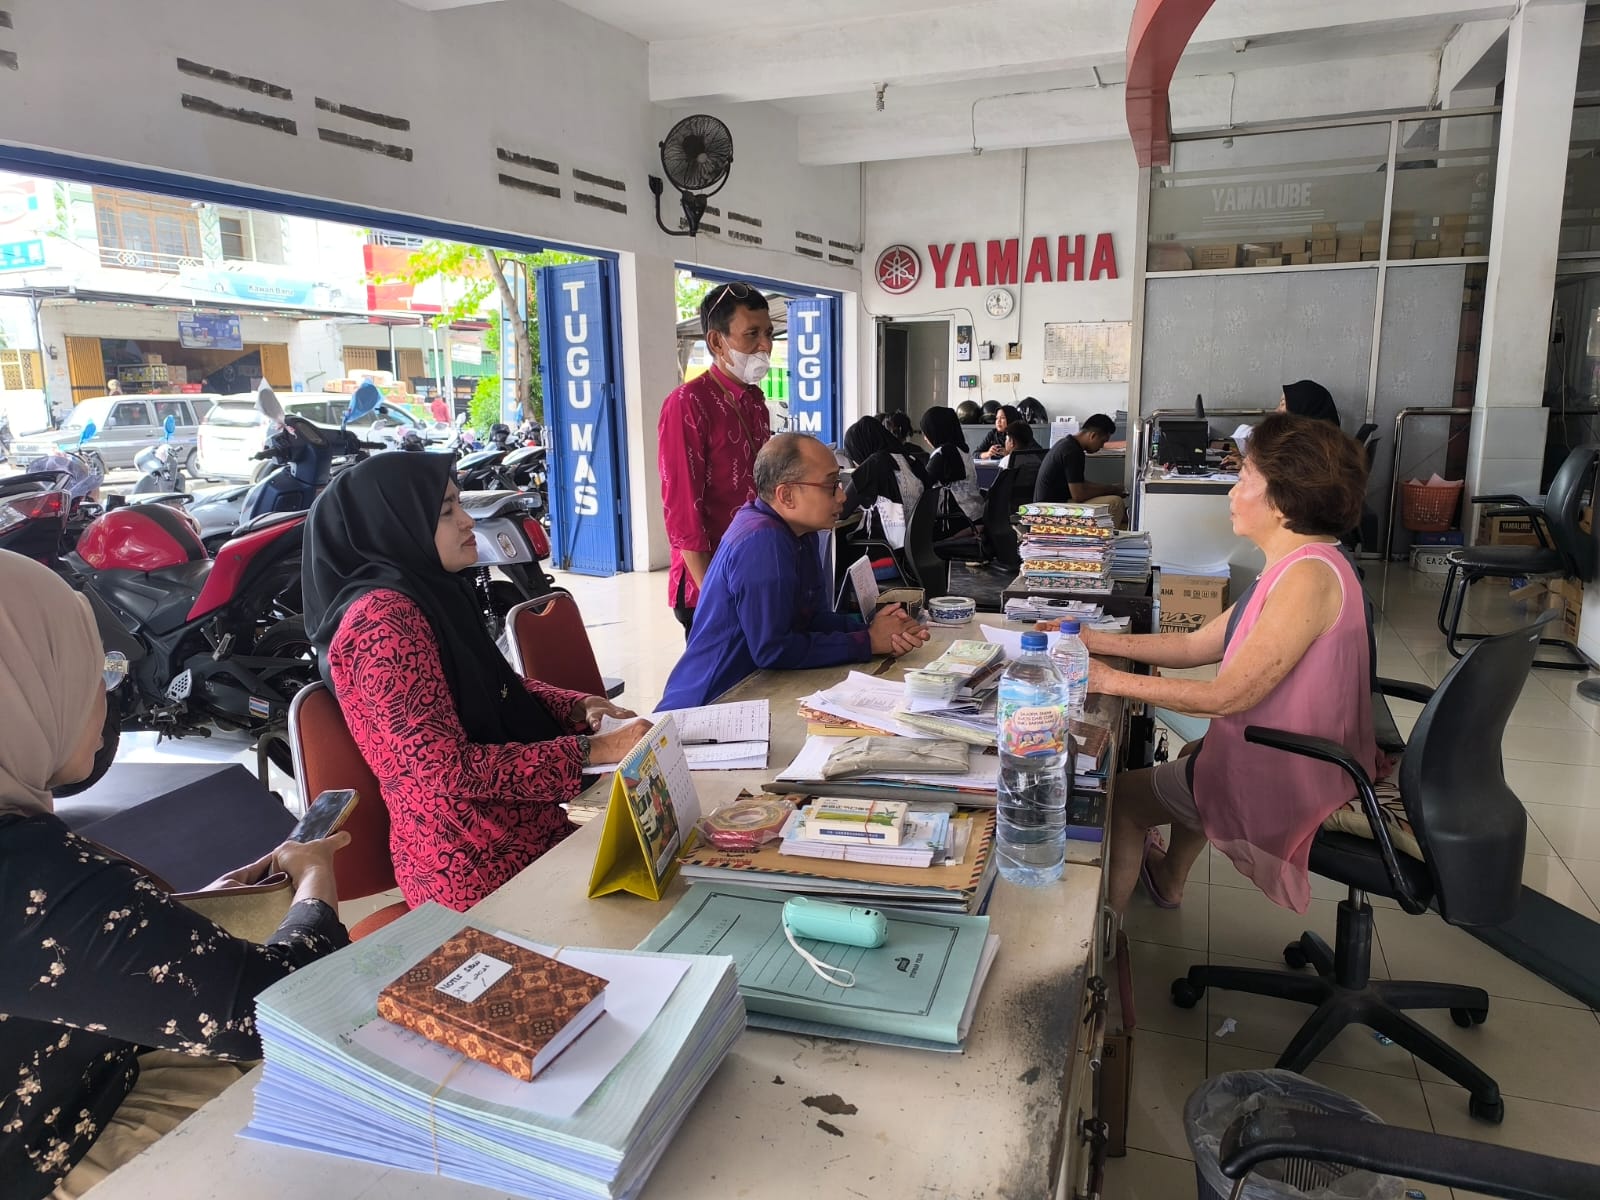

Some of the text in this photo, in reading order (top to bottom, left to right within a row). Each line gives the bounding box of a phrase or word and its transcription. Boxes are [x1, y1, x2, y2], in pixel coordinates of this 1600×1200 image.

[1211, 182, 1313, 212] YAMALUBE
[928, 233, 1118, 289] YAMAHA
[798, 311, 821, 401] TUGU
[562, 281, 599, 515] TUGU MAS
[1502, 522, 1532, 530] YAMALUBE
[1426, 556, 1437, 565] EA
